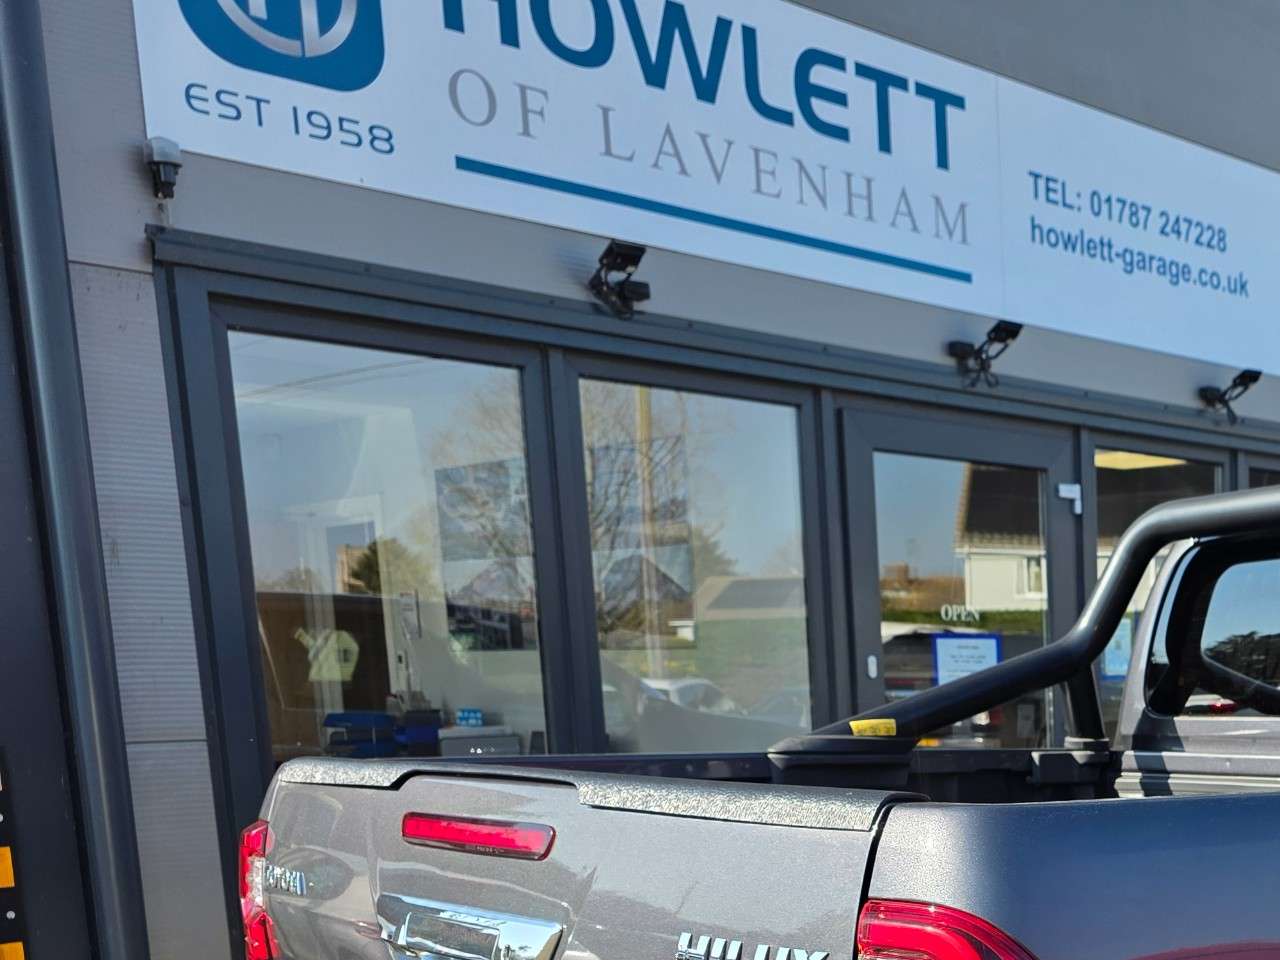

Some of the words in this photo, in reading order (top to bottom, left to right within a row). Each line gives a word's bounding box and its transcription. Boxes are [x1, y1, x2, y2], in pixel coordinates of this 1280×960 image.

[184, 82, 271, 127] EST
[292, 105, 395, 154] 1958
[448, 68, 550, 139] OF
[596, 104, 971, 245] LAVENHAM
[1028, 170, 1082, 212] TEL:
[1089, 189, 1151, 232] 01787
[1158, 210, 1228, 253] 247228
[1029, 215, 1250, 298] howlett-garage.co.uk
[940, 603, 980, 622] OPEN
